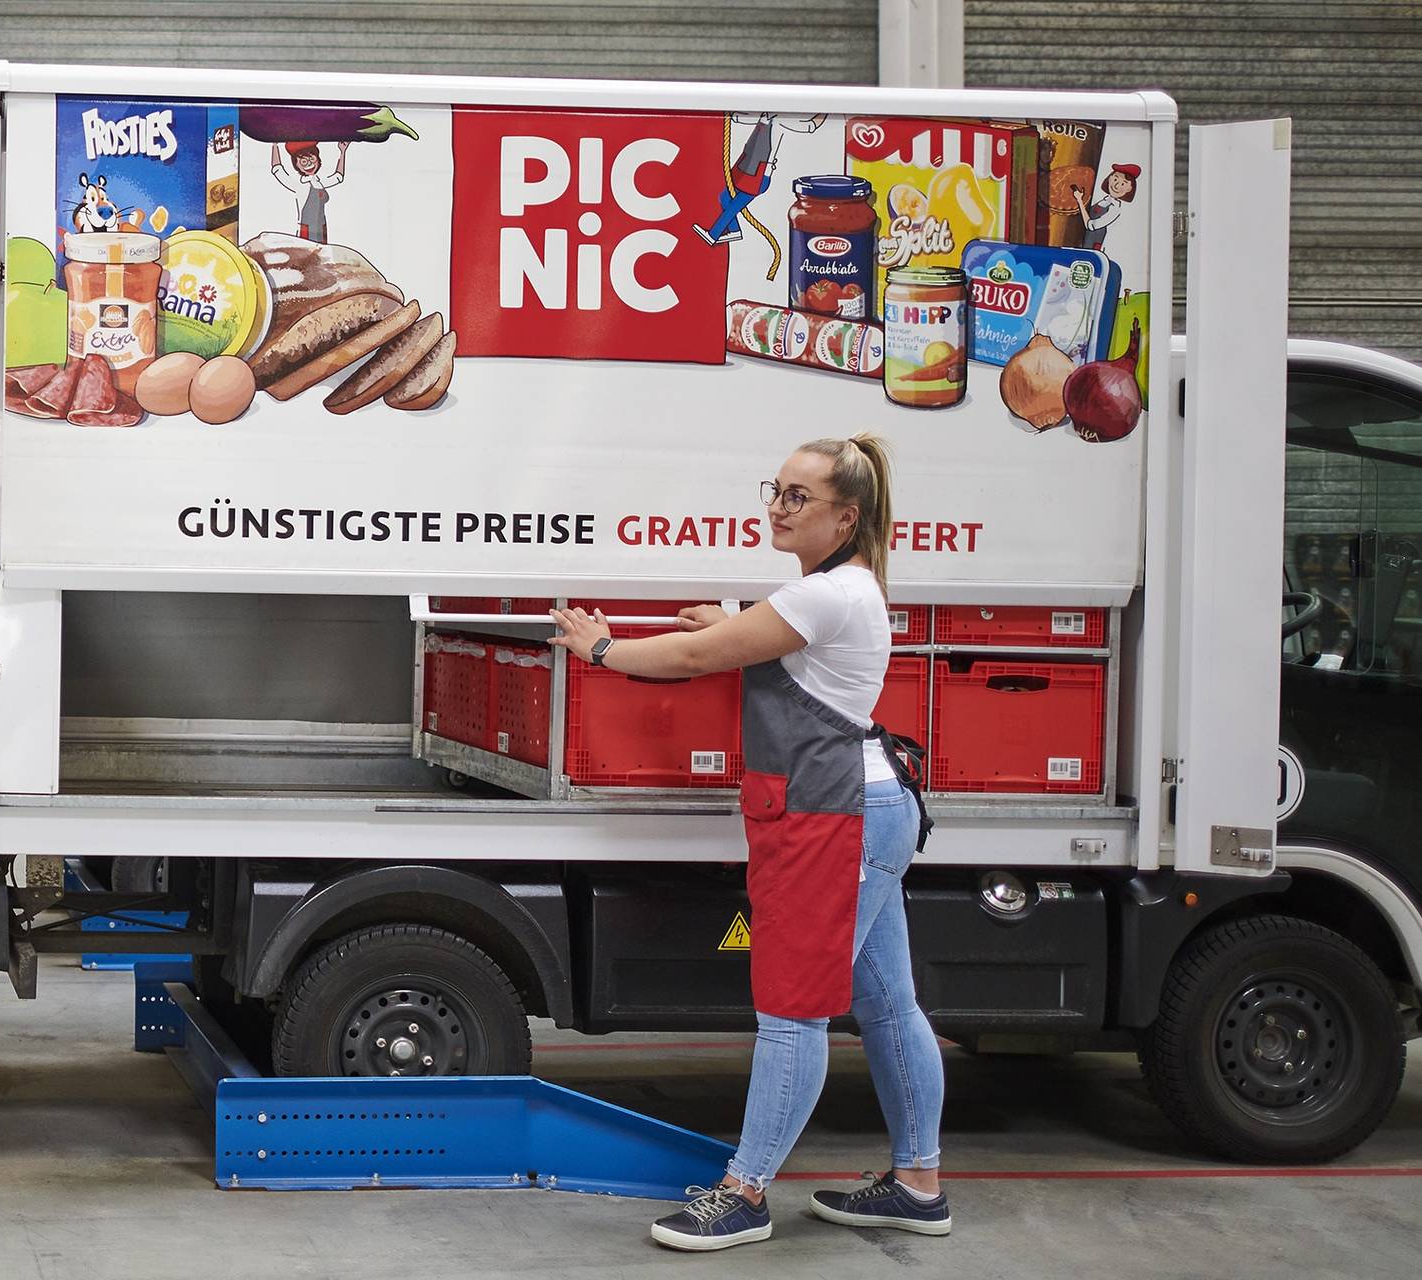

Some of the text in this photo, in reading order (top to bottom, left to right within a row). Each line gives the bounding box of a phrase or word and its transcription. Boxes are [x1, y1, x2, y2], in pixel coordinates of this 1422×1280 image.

[82, 108, 177, 161] FROSTIES
[1042, 119, 1088, 141] Rolle
[500, 135, 681, 222] PIC
[816, 240, 848, 252] Barilla
[889, 215, 955, 267] Split
[799, 258, 859, 275] Arrabbiata
[156, 286, 216, 326] Rama
[971, 283, 1026, 310] BUKO
[91, 330, 137, 352] Extra
[177, 498, 762, 548] GÜNSTIGSTE PREISE GRATIS
